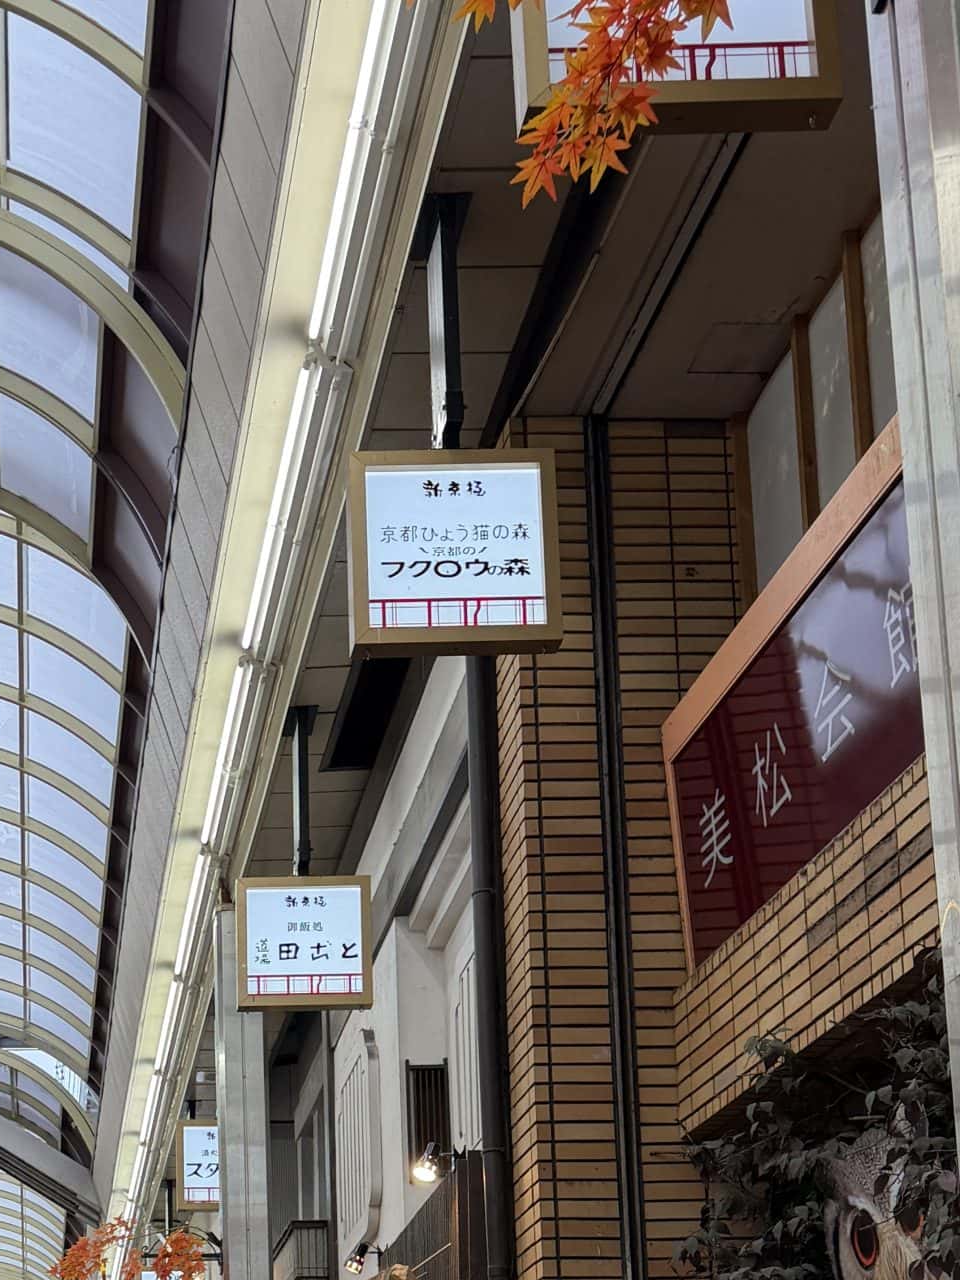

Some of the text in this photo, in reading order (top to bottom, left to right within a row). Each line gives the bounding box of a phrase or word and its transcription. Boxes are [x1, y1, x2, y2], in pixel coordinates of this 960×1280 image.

[422, 480, 487, 498] 新京極
[380, 522, 531, 544] 京都ひょう猫の森
[380, 558, 532, 579] フクロウの森
